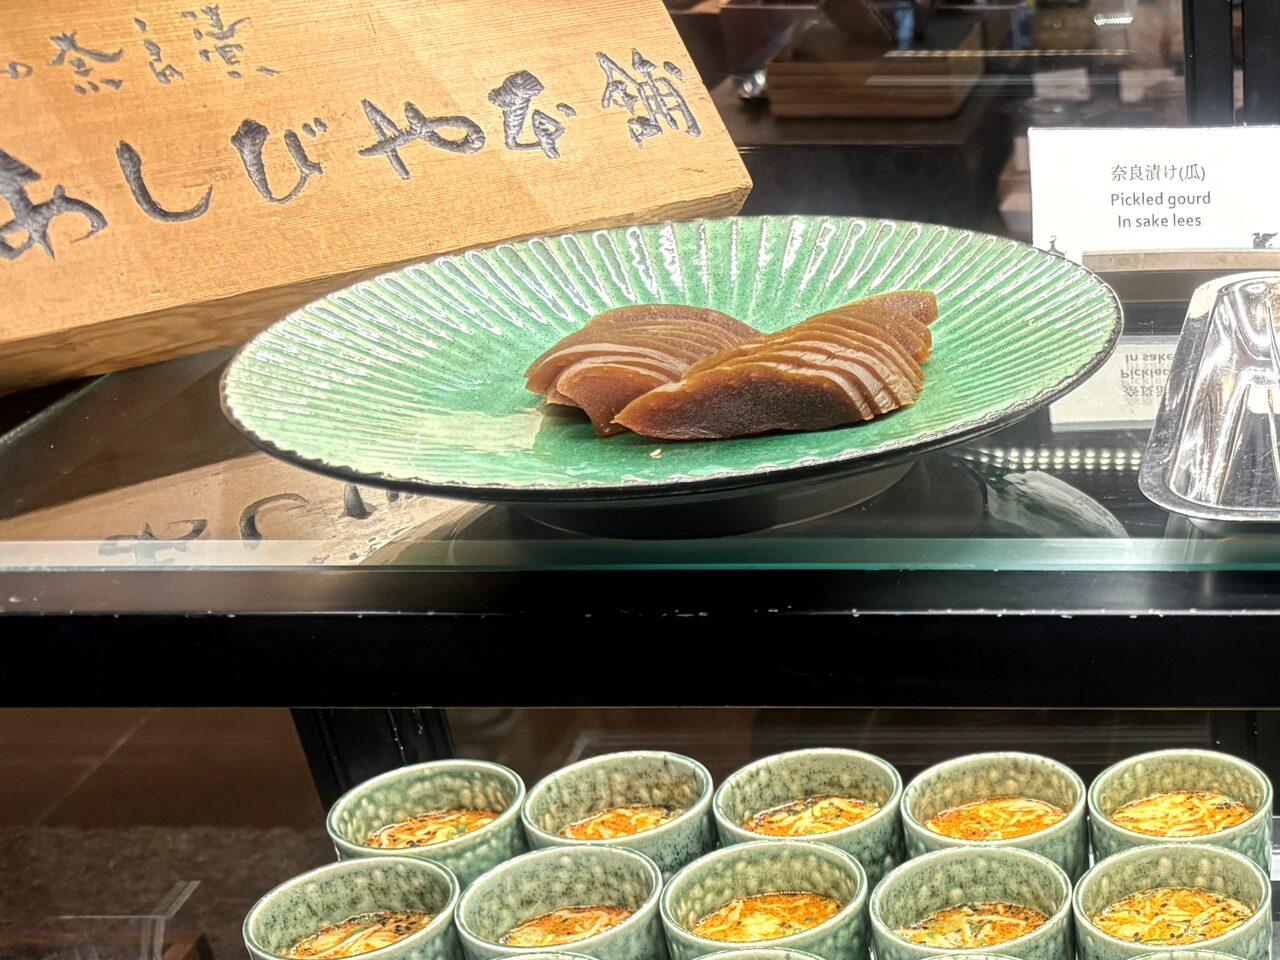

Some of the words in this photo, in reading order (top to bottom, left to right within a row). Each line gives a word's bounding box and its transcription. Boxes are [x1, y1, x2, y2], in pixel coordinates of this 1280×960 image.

[1110, 164, 1206, 182] 奈良漬け(瓜)
[1110, 192, 1164, 206] Pickled
[1168, 191, 1211, 209] gourd
[1118, 215, 1132, 228] In
[1135, 214, 1169, 227] sake
[1173, 213, 1202, 227] lees
